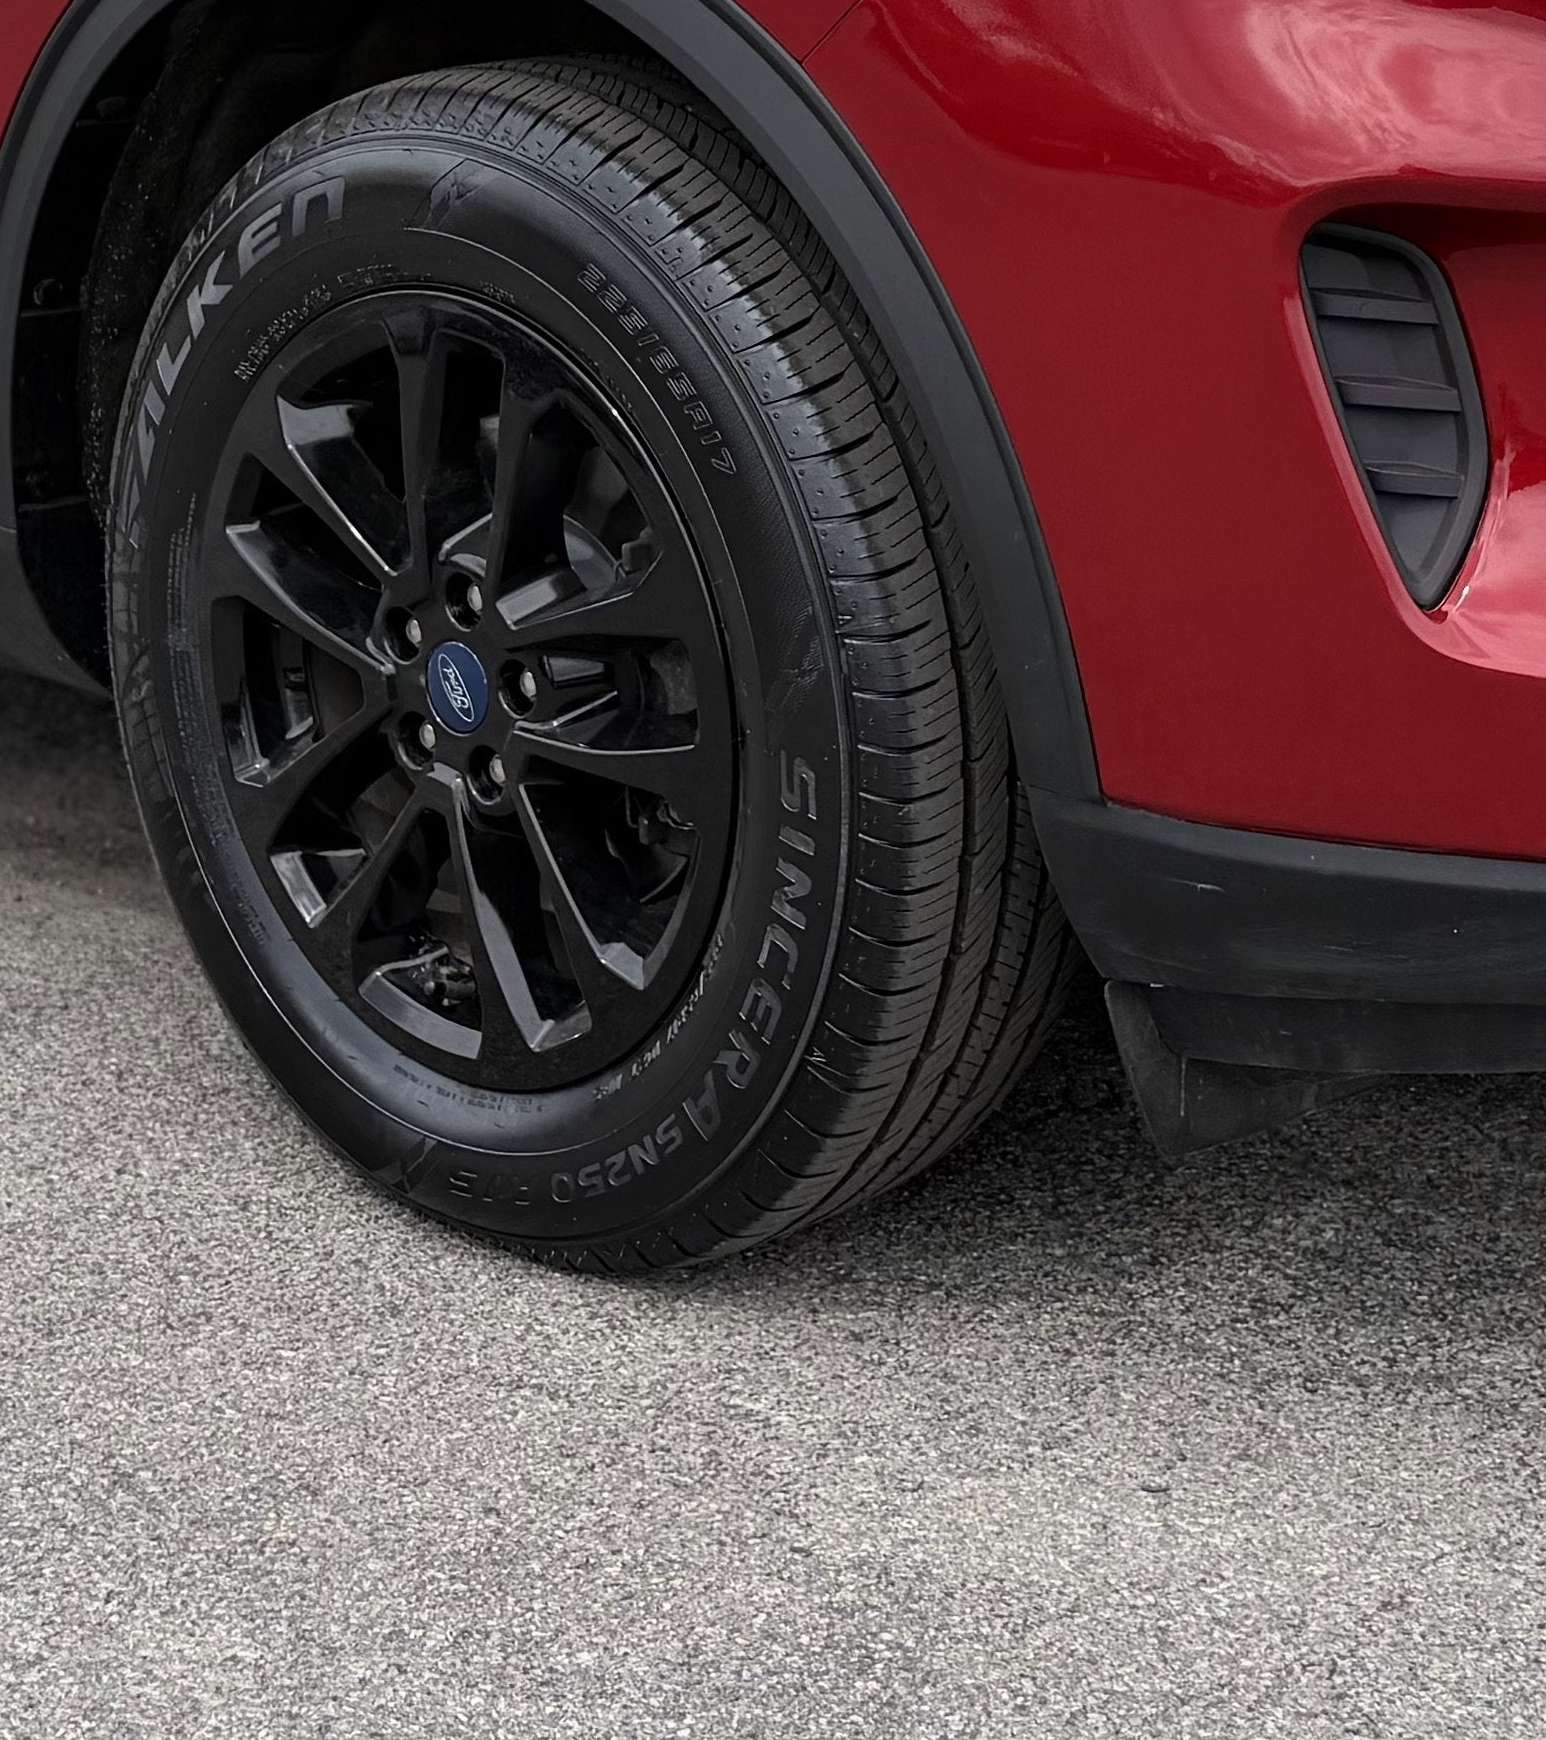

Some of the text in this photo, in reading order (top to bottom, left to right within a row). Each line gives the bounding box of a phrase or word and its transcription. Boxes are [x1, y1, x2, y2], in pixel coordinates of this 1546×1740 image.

[119, 175, 347, 550] FALKEN
[442, 665, 469, 709] Ford
[682, 748, 818, 1142] SINCERA
[549, 1112, 684, 1204] SN250
